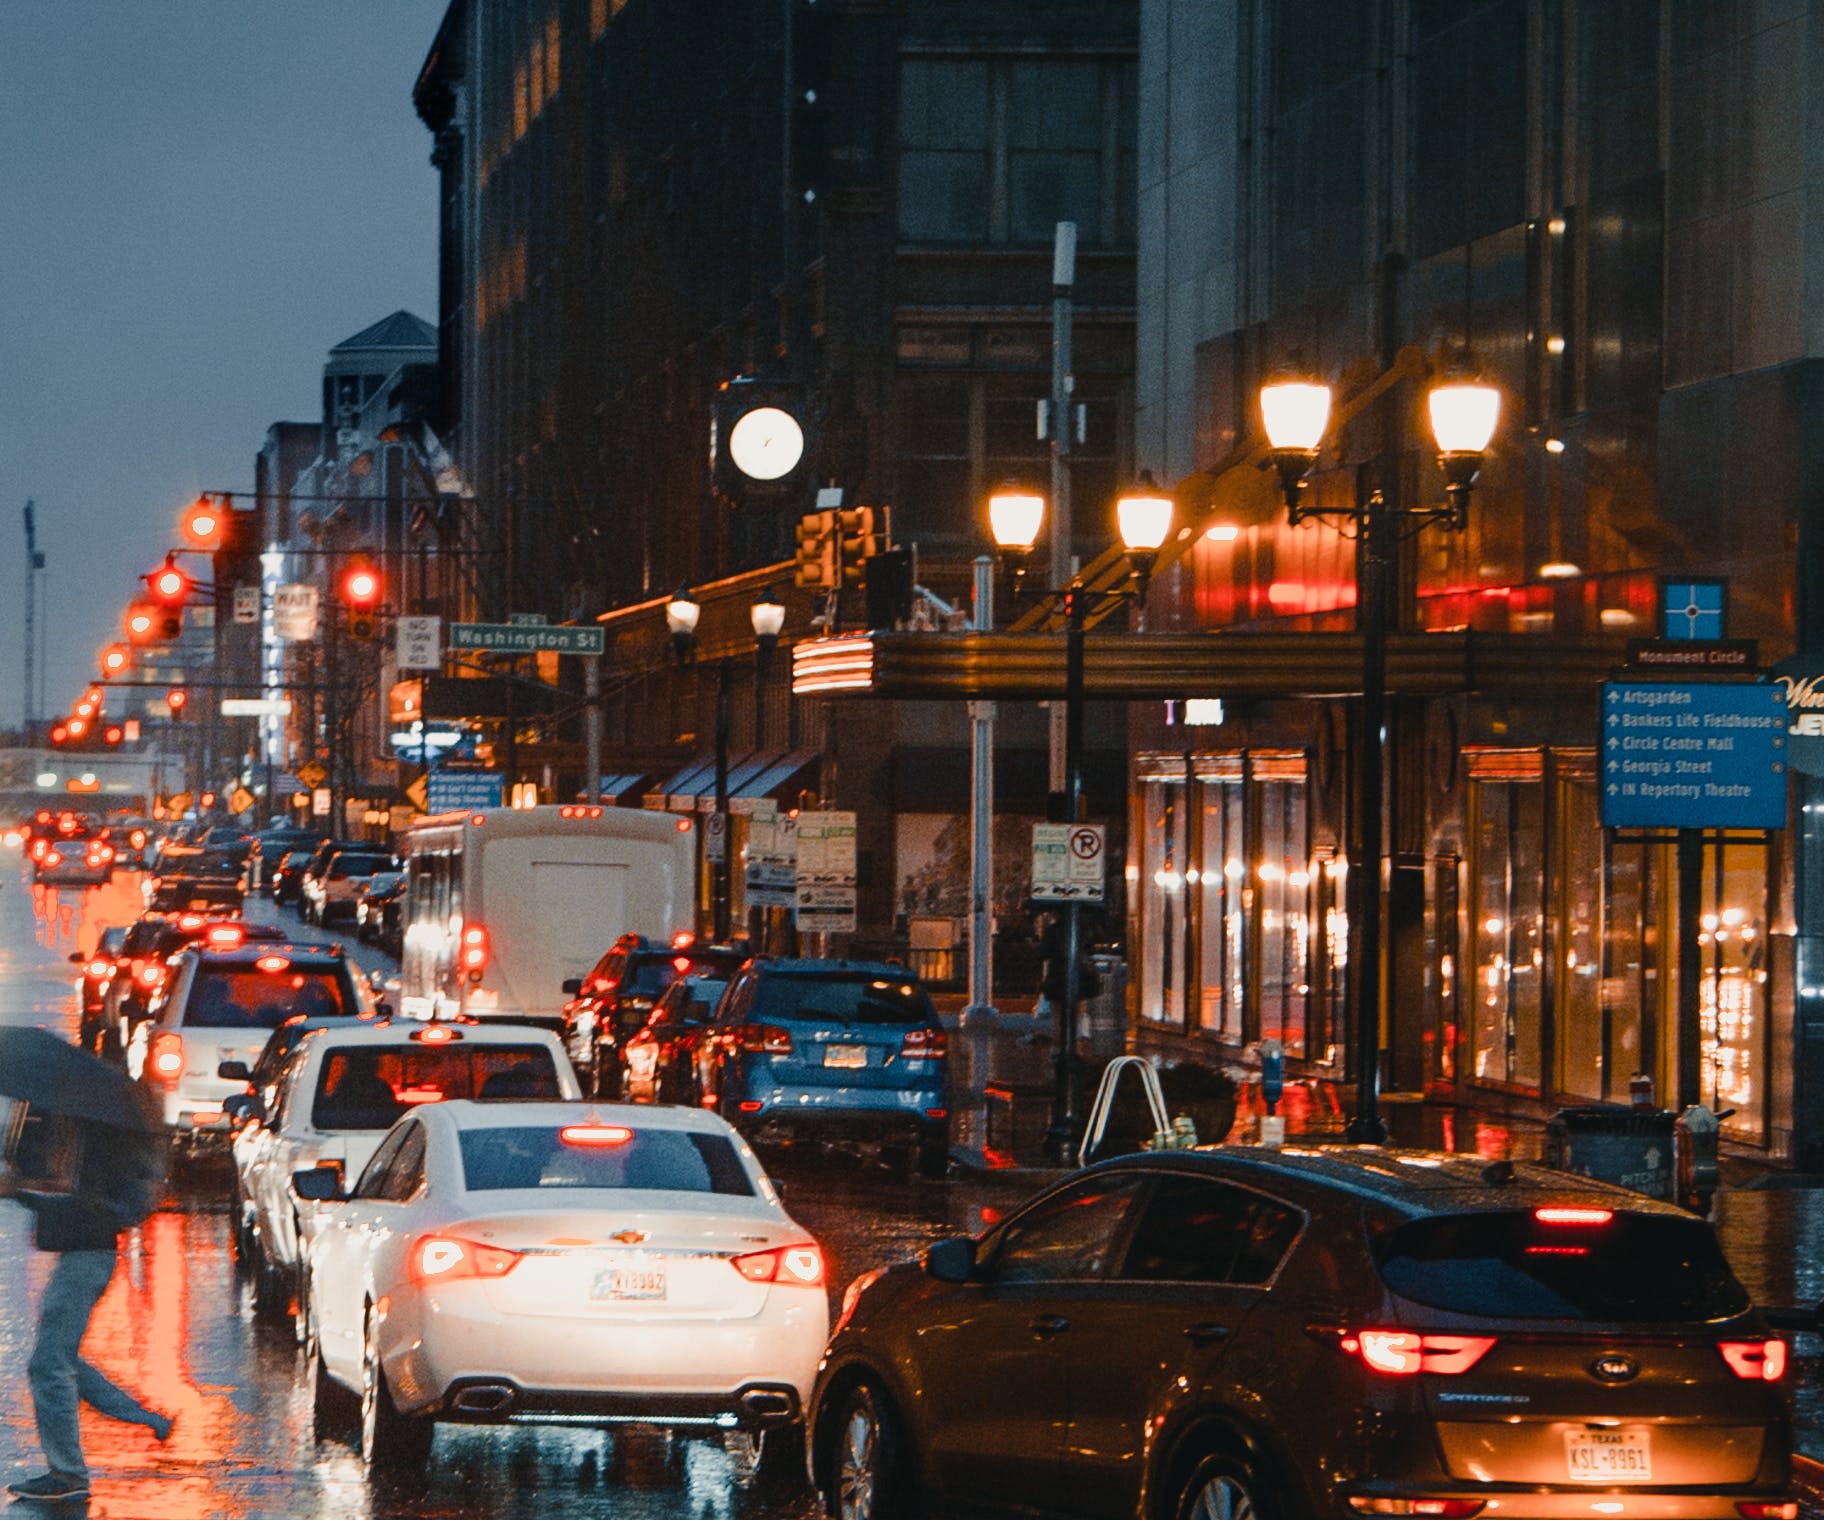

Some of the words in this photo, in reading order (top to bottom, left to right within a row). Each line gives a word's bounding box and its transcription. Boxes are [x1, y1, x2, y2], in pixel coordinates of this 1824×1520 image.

[278, 591, 312, 607] WAIT
[409, 619, 427, 630] NO
[406, 633, 431, 643] TURN
[458, 629, 570, 649] Washington
[576, 633, 597, 648] St
[411, 644, 425, 653] ON
[409, 654, 427, 664] RED
[1638, 651, 1705, 664] Monument
[1708, 651, 1746, 664] Circle
[1623, 690, 1692, 707] Artsgarden
[1622, 714, 1673, 728] Bankers
[1676, 714, 1700, 728] Life
[1703, 714, 1772, 729] Fieldhouse
[1622, 737, 1659, 751] Circle
[1662, 737, 1703, 751] Centre
[1707, 737, 1734, 751] Mall
[1622, 759, 1671, 776] Georgia
[1675, 760, 1713, 774] Street
[1622, 783, 1636, 796] IN
[1639, 782, 1701, 800] Repertory
[1704, 783, 1751, 797] Theatre
[1591, 1434, 1623, 1444] TEXAS
